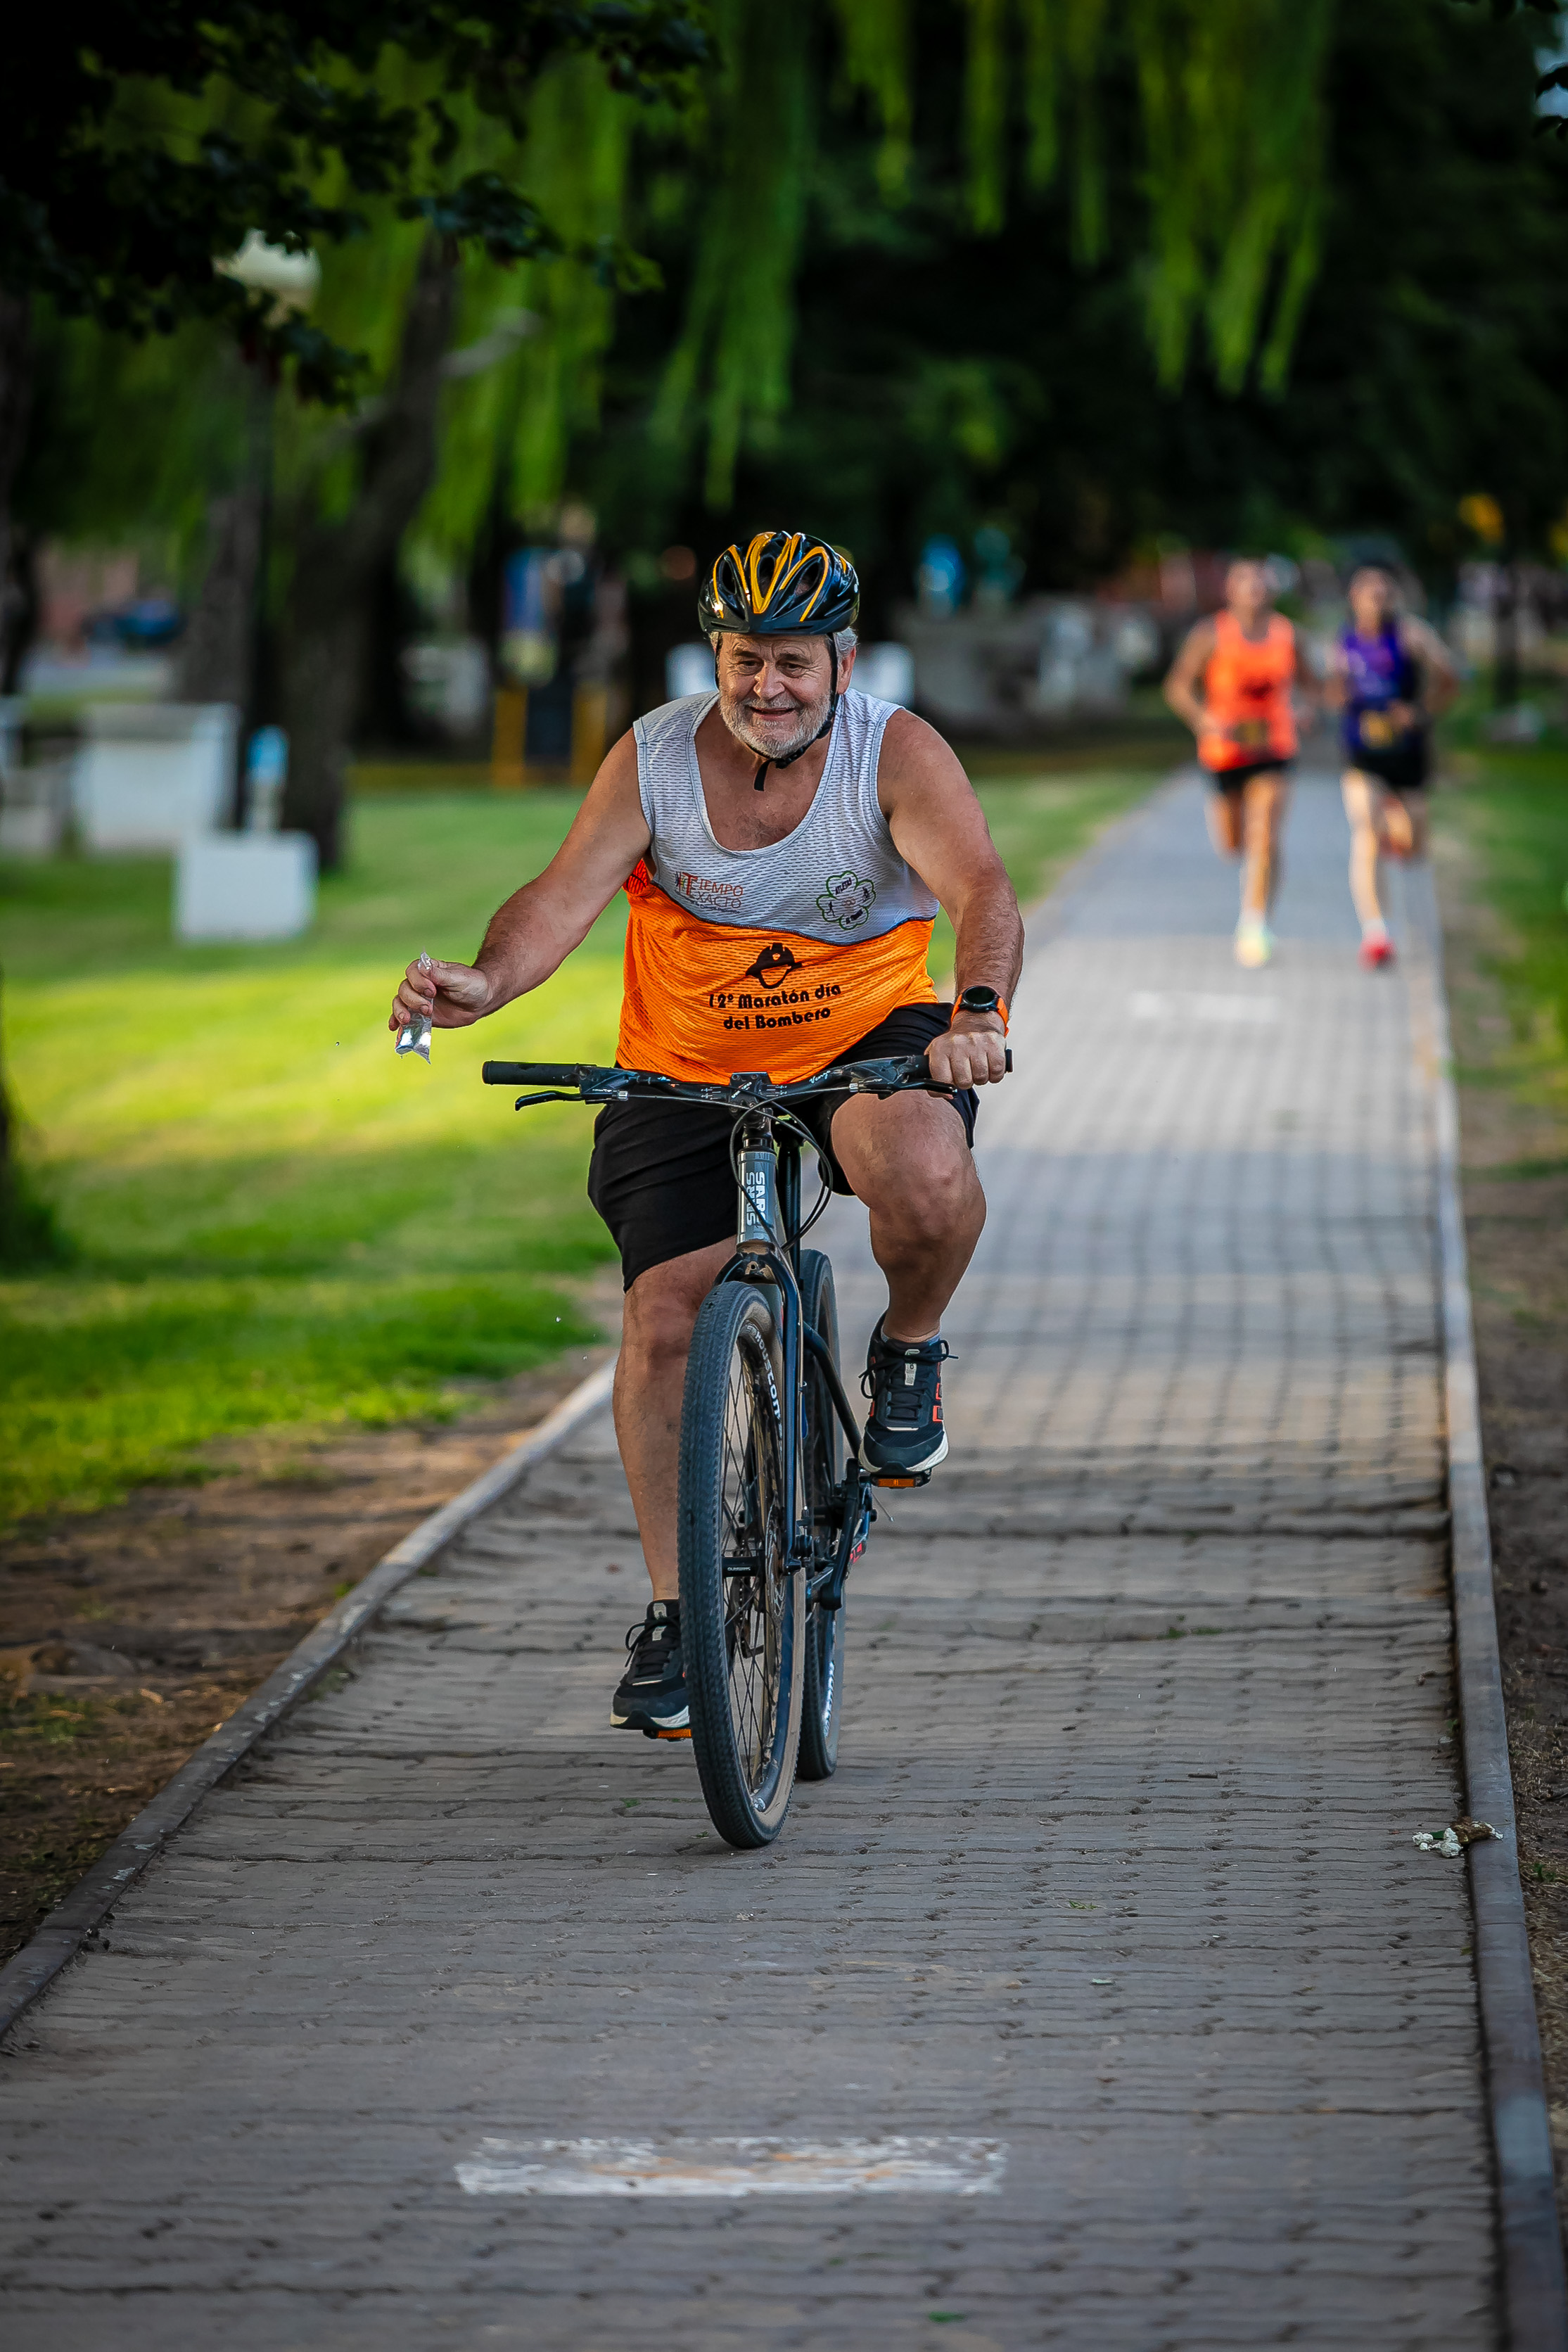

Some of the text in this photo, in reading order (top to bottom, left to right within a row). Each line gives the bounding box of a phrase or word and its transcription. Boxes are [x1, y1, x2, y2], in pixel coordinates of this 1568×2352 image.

[681, 872, 744, 897] TIEMPO
[739, 989, 810, 1009] Maratón
[815, 983, 841, 999] día
[723, 1007, 831, 1030] del Bombero
